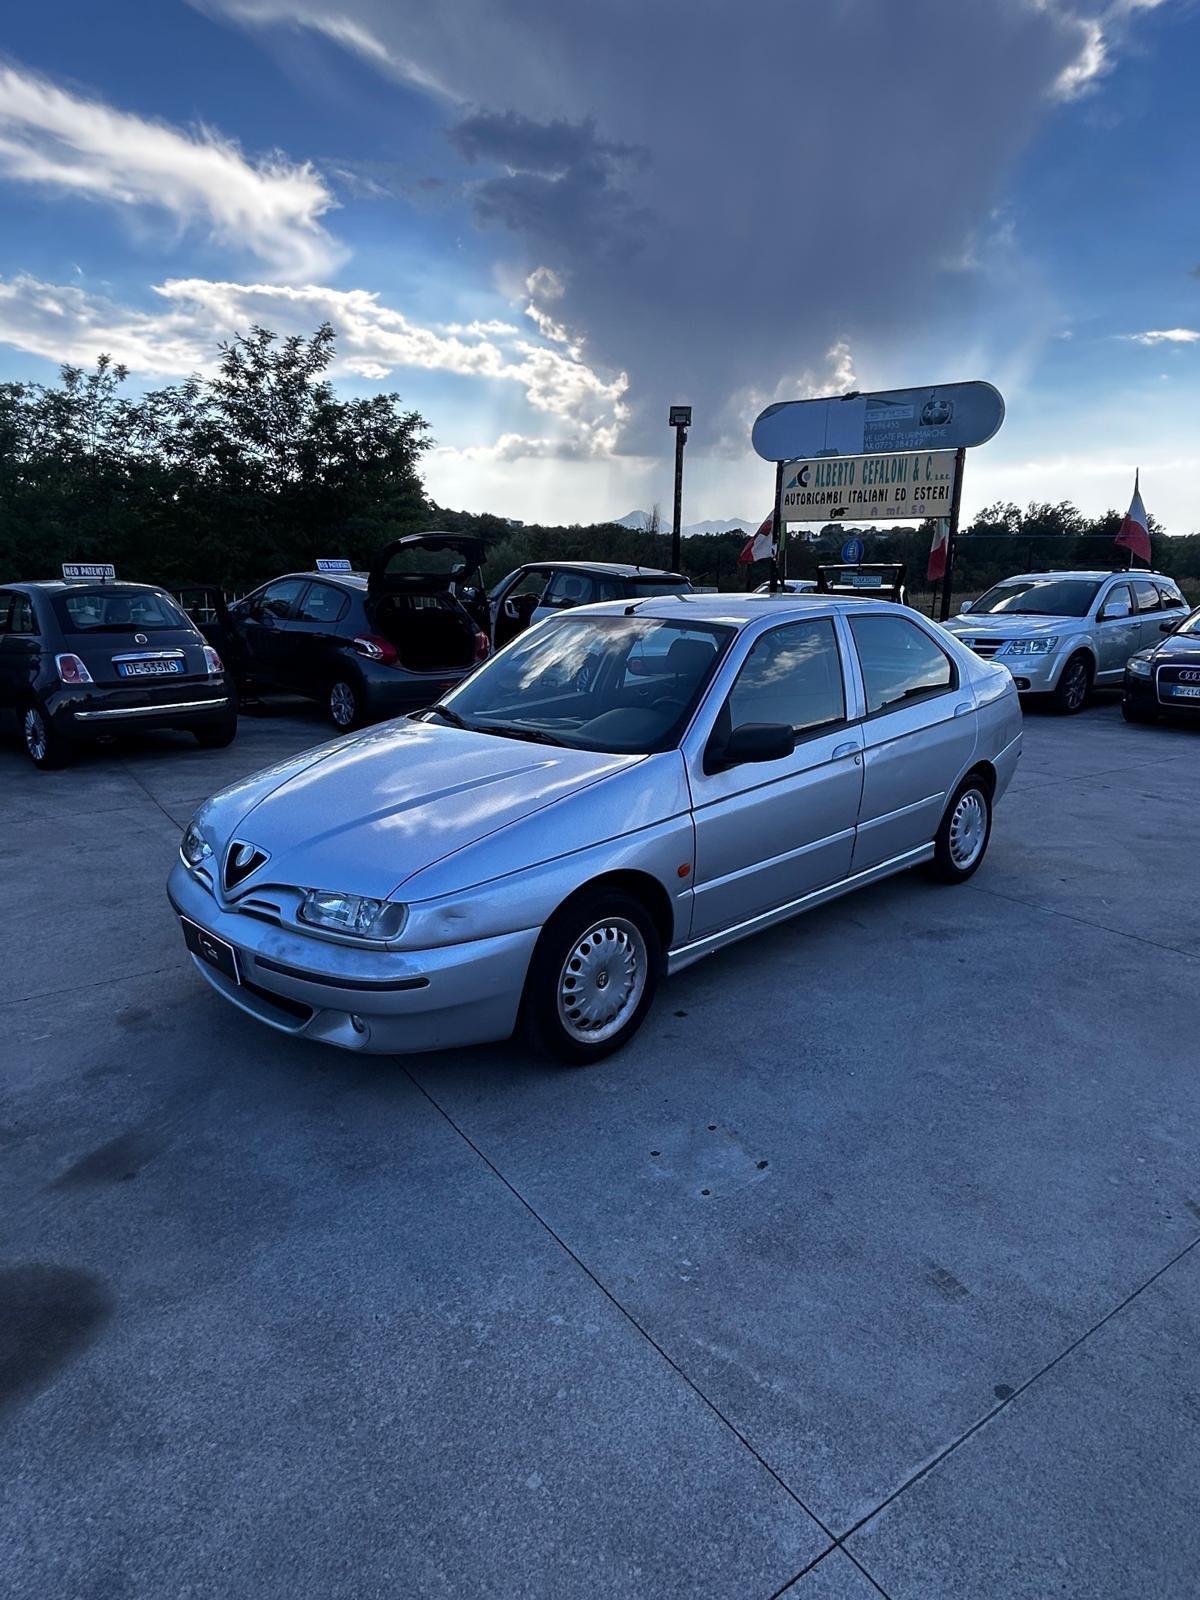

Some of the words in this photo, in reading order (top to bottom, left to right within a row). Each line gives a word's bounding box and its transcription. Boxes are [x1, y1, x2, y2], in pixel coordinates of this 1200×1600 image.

[814, 461, 855, 488] ALBERTO
[862, 458, 908, 485] CEFALONI
[912, 457, 919, 481] &
[785, 490, 842, 505] AUTORICAMBI
[848, 488, 888, 503] ITALIANI
[895, 488, 906, 501] ED
[914, 486, 949, 500] ESTERI
[911, 504, 925, 515] 50
